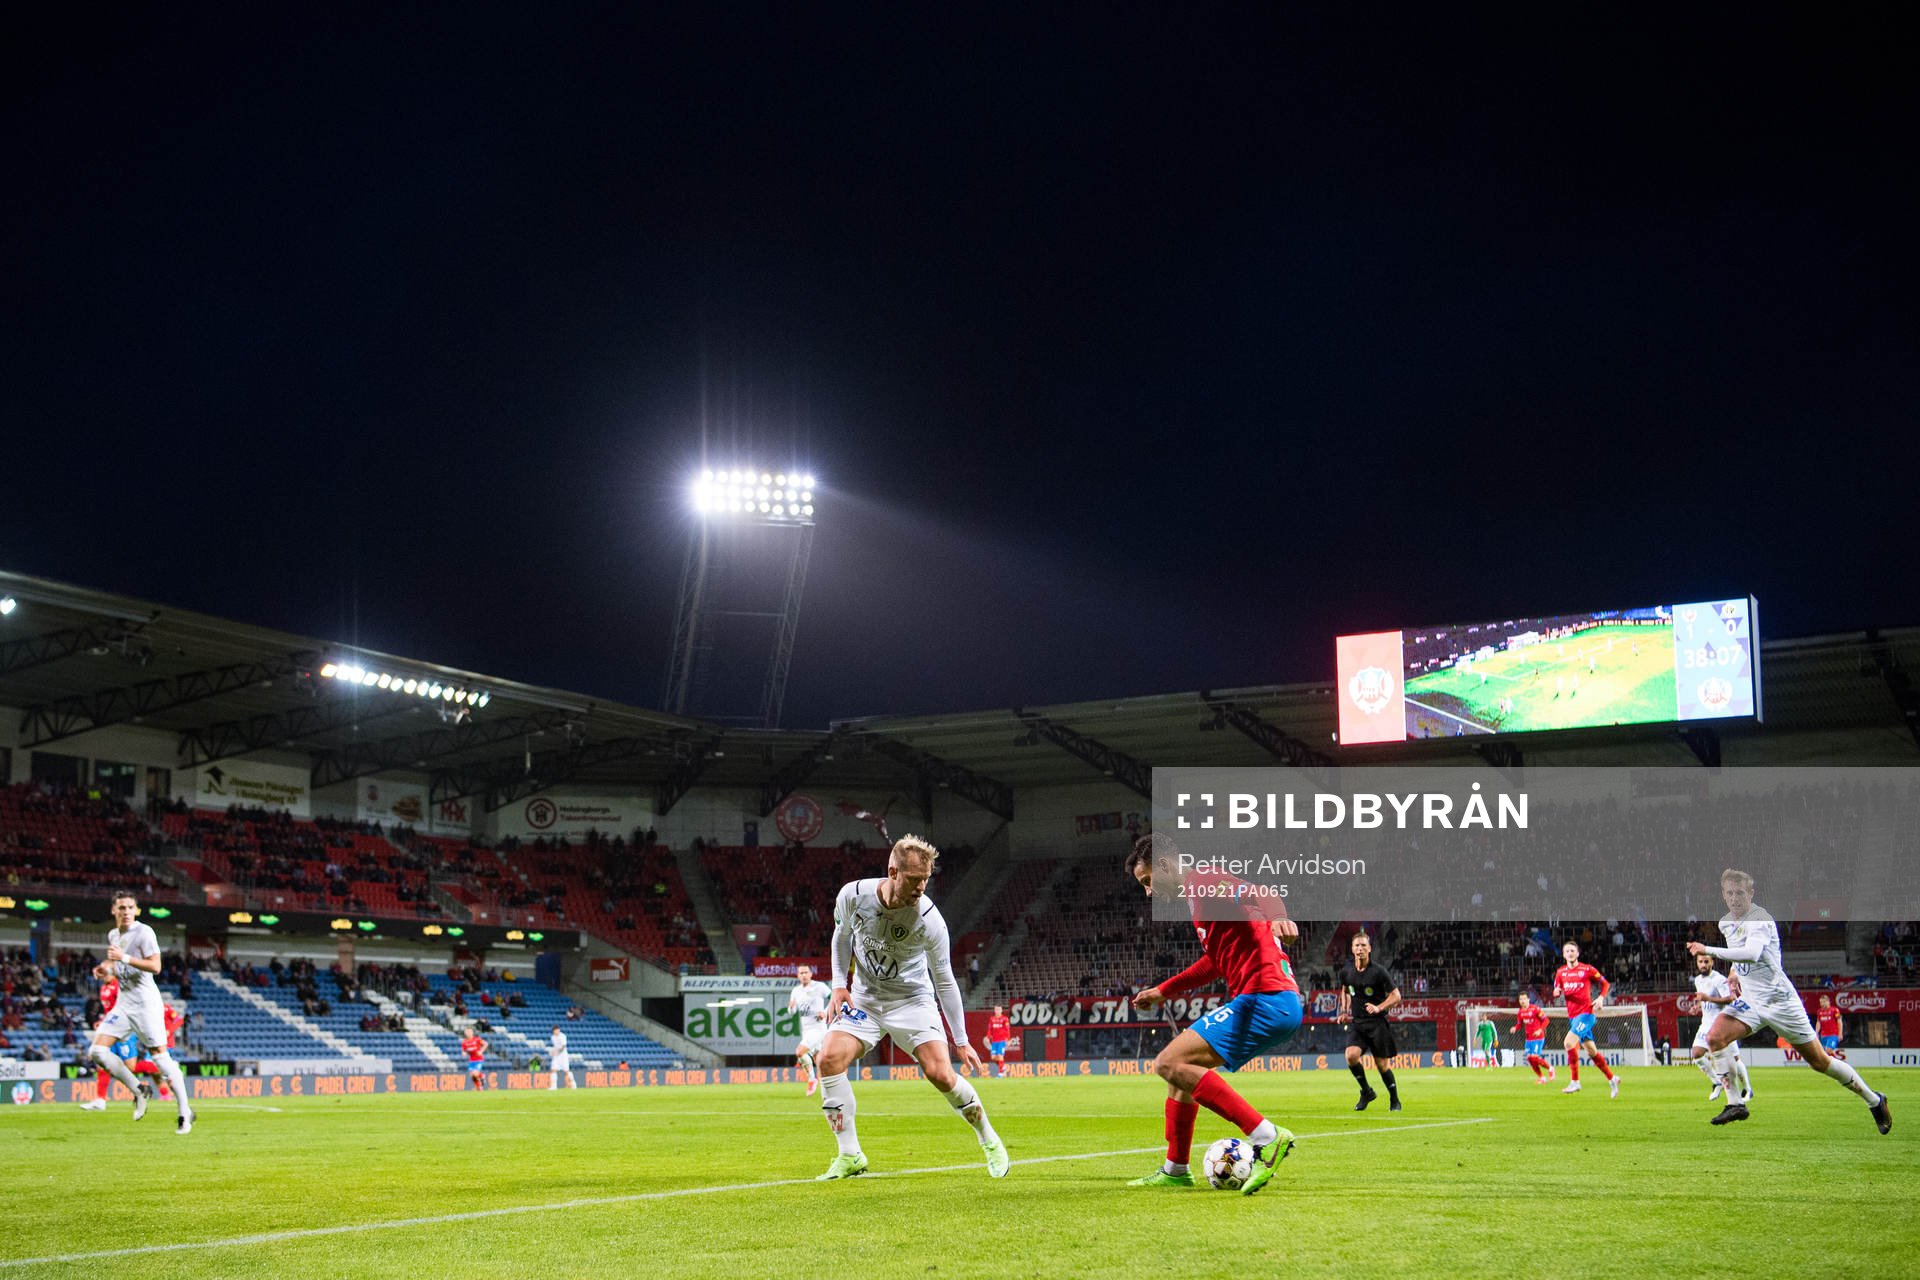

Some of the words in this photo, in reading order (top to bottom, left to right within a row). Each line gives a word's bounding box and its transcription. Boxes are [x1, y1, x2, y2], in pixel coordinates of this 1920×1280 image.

[1684, 645, 1742, 668] 38:07
[1388, 1001, 1429, 1017] arlsberg
[1835, 992, 1886, 1010] Carlsberg
[1089, 996, 1129, 1023] STÅ
[686, 998, 800, 1039] akea
[1004, 1062, 1034, 1077] PADEL
[1037, 1062, 1066, 1077] CREW
[1108, 1060, 1142, 1075] PADEL
[1269, 1055, 1302, 1071] CREW
[507, 1073, 532, 1089] PADEL
[585, 1071, 609, 1087] PADEL
[609, 1071, 631, 1086] CREW
[665, 1070, 686, 1085] PADEL
[687, 1070, 706, 1085] CREW
[730, 1069, 749, 1084] PADEL
[749, 1069, 767, 1083] CREW
[890, 1066, 921, 1081] PADEL
[193, 1079, 229, 1098] PADEL
[230, 1077, 263, 1097] CREW
[315, 1076, 346, 1095] PADEL
[346, 1075, 376, 1093] CREW
[410, 1074, 439, 1092] PADEL
[439, 1073, 466, 1091] CREW
